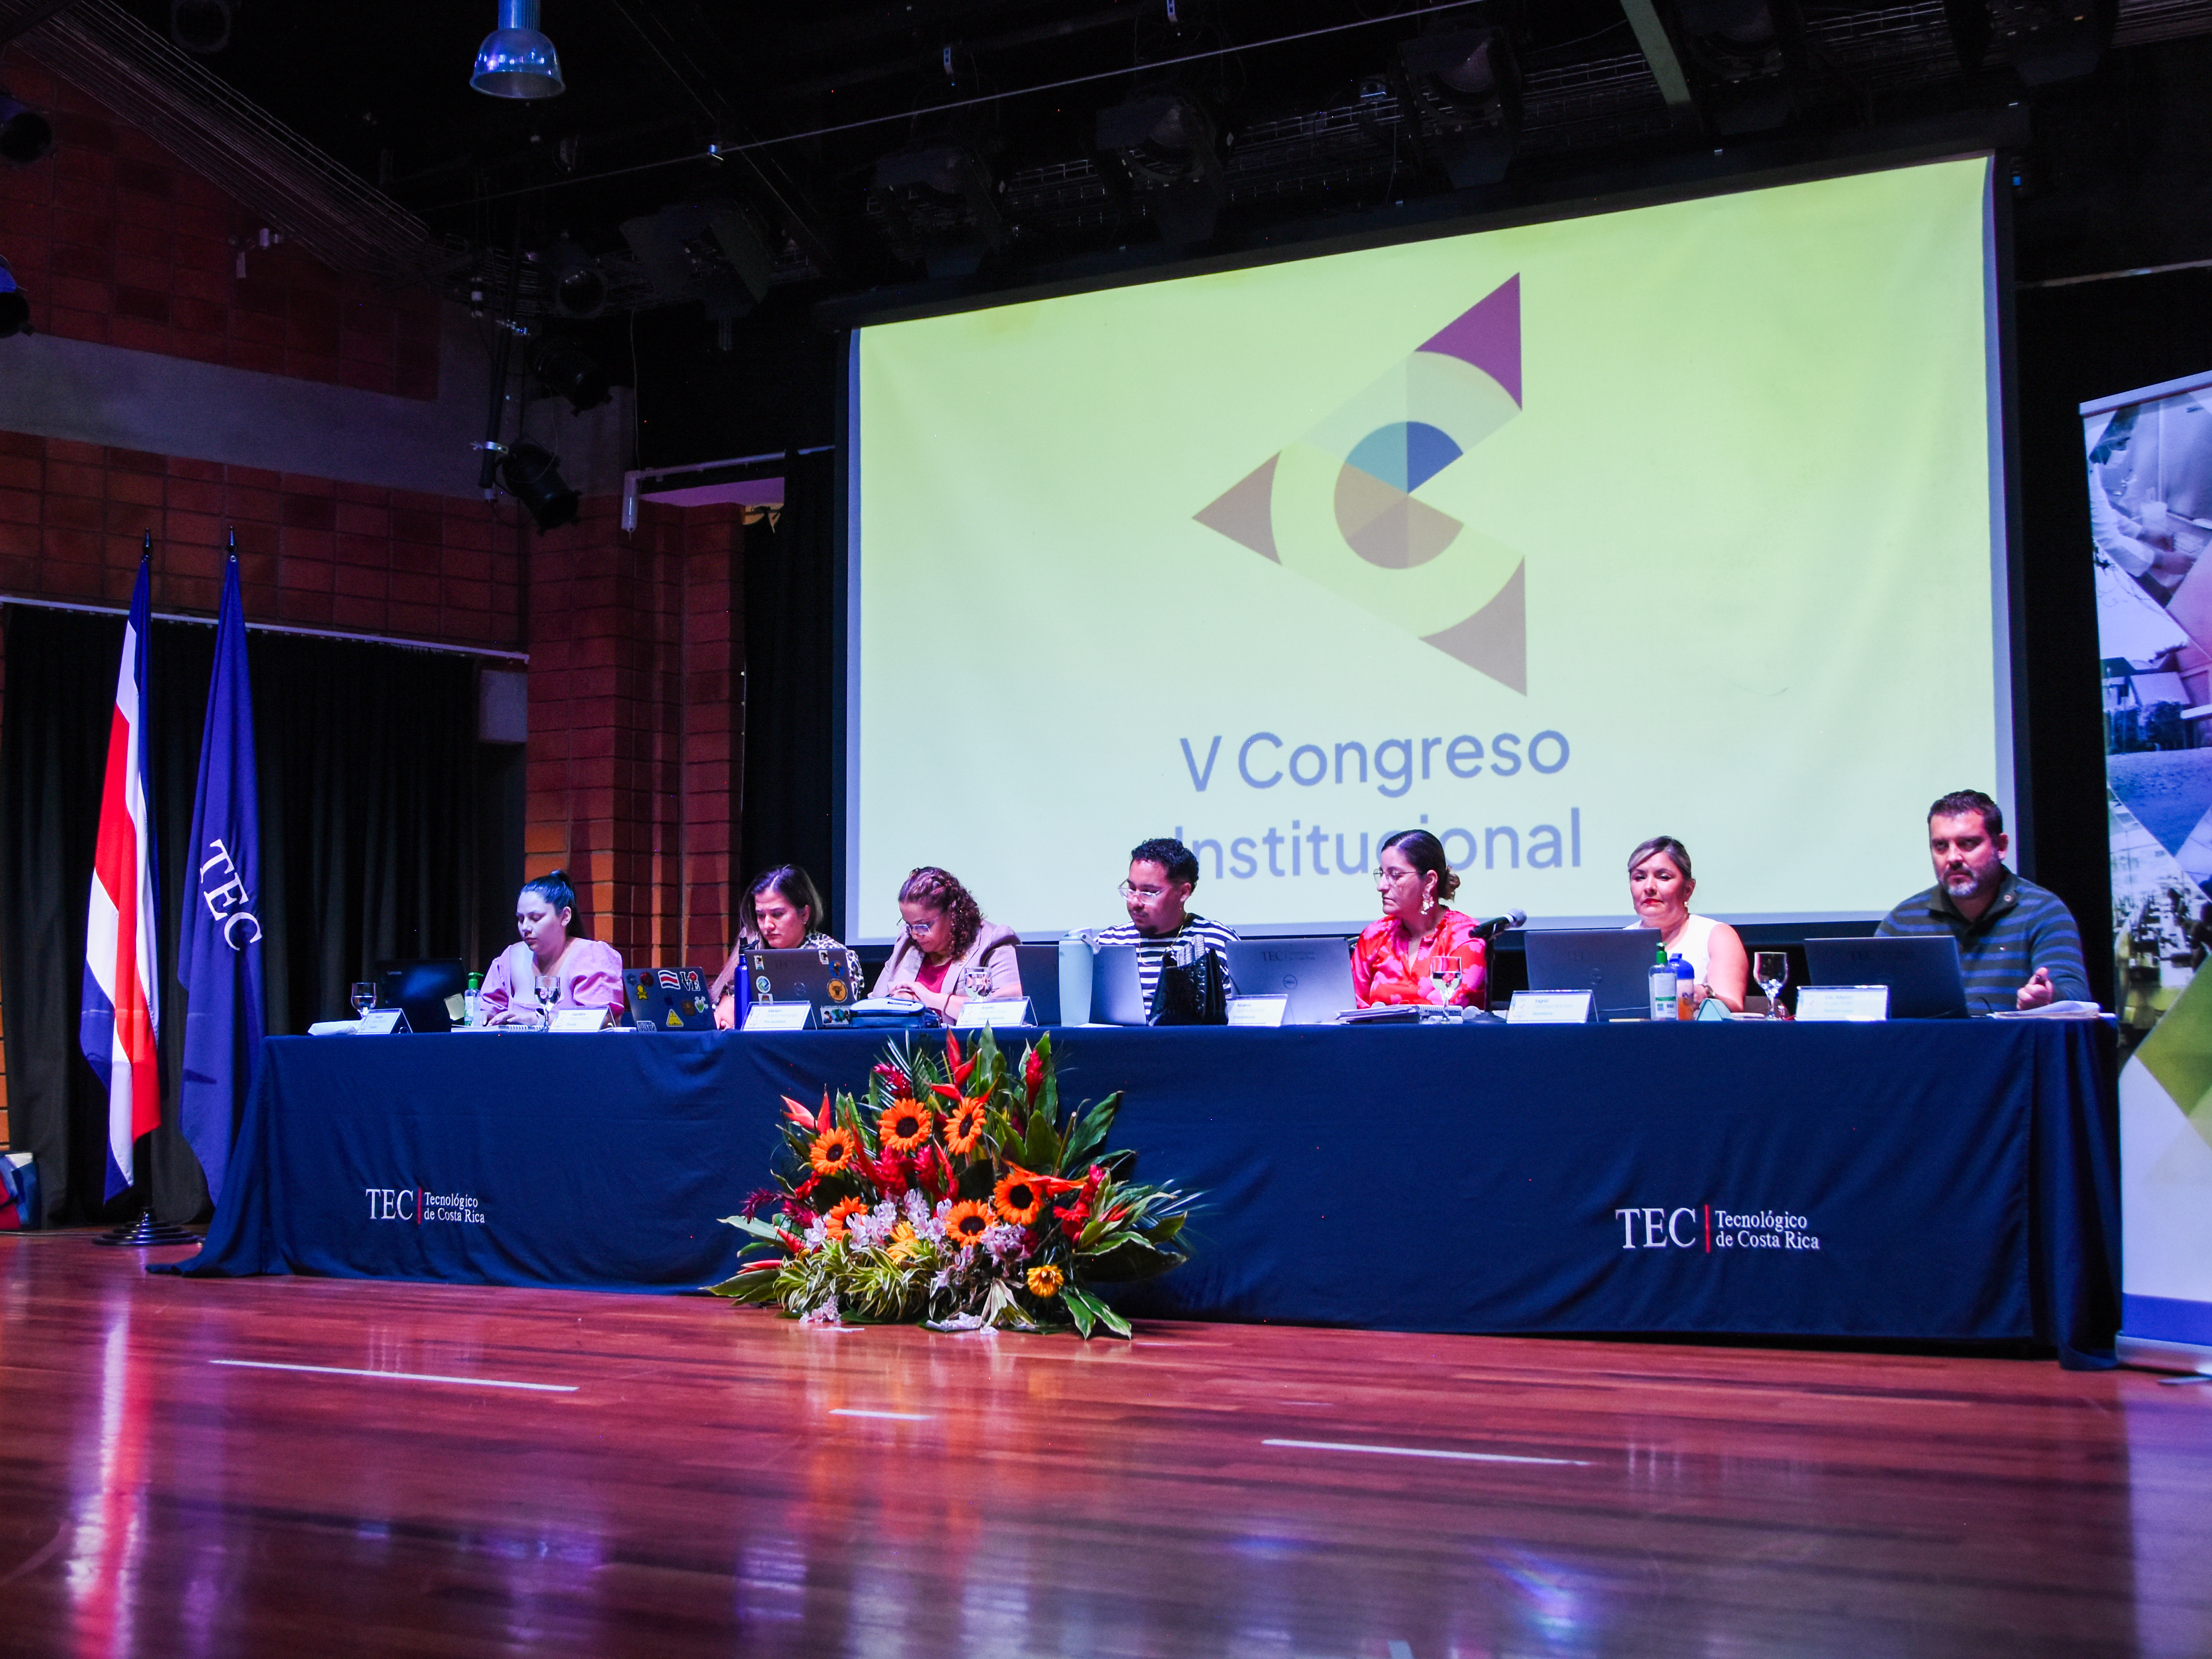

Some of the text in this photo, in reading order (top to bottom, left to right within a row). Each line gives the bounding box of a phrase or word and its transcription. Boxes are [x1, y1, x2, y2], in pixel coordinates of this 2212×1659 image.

[1179, 729, 1571, 798] V Congreso
[1175, 807, 1581, 880] nstituonal
[200, 839, 262, 951] TEC
[365, 1188, 413, 1220] TEC
[424, 1192, 478, 1210] Tecnológico
[424, 1207, 485, 1223] de Costa Rica
[1615, 1207, 1696, 1249] TEC
[1715, 1210, 1807, 1232] Tecnológico
[1715, 1230, 1820, 1250] de Costa Rica
